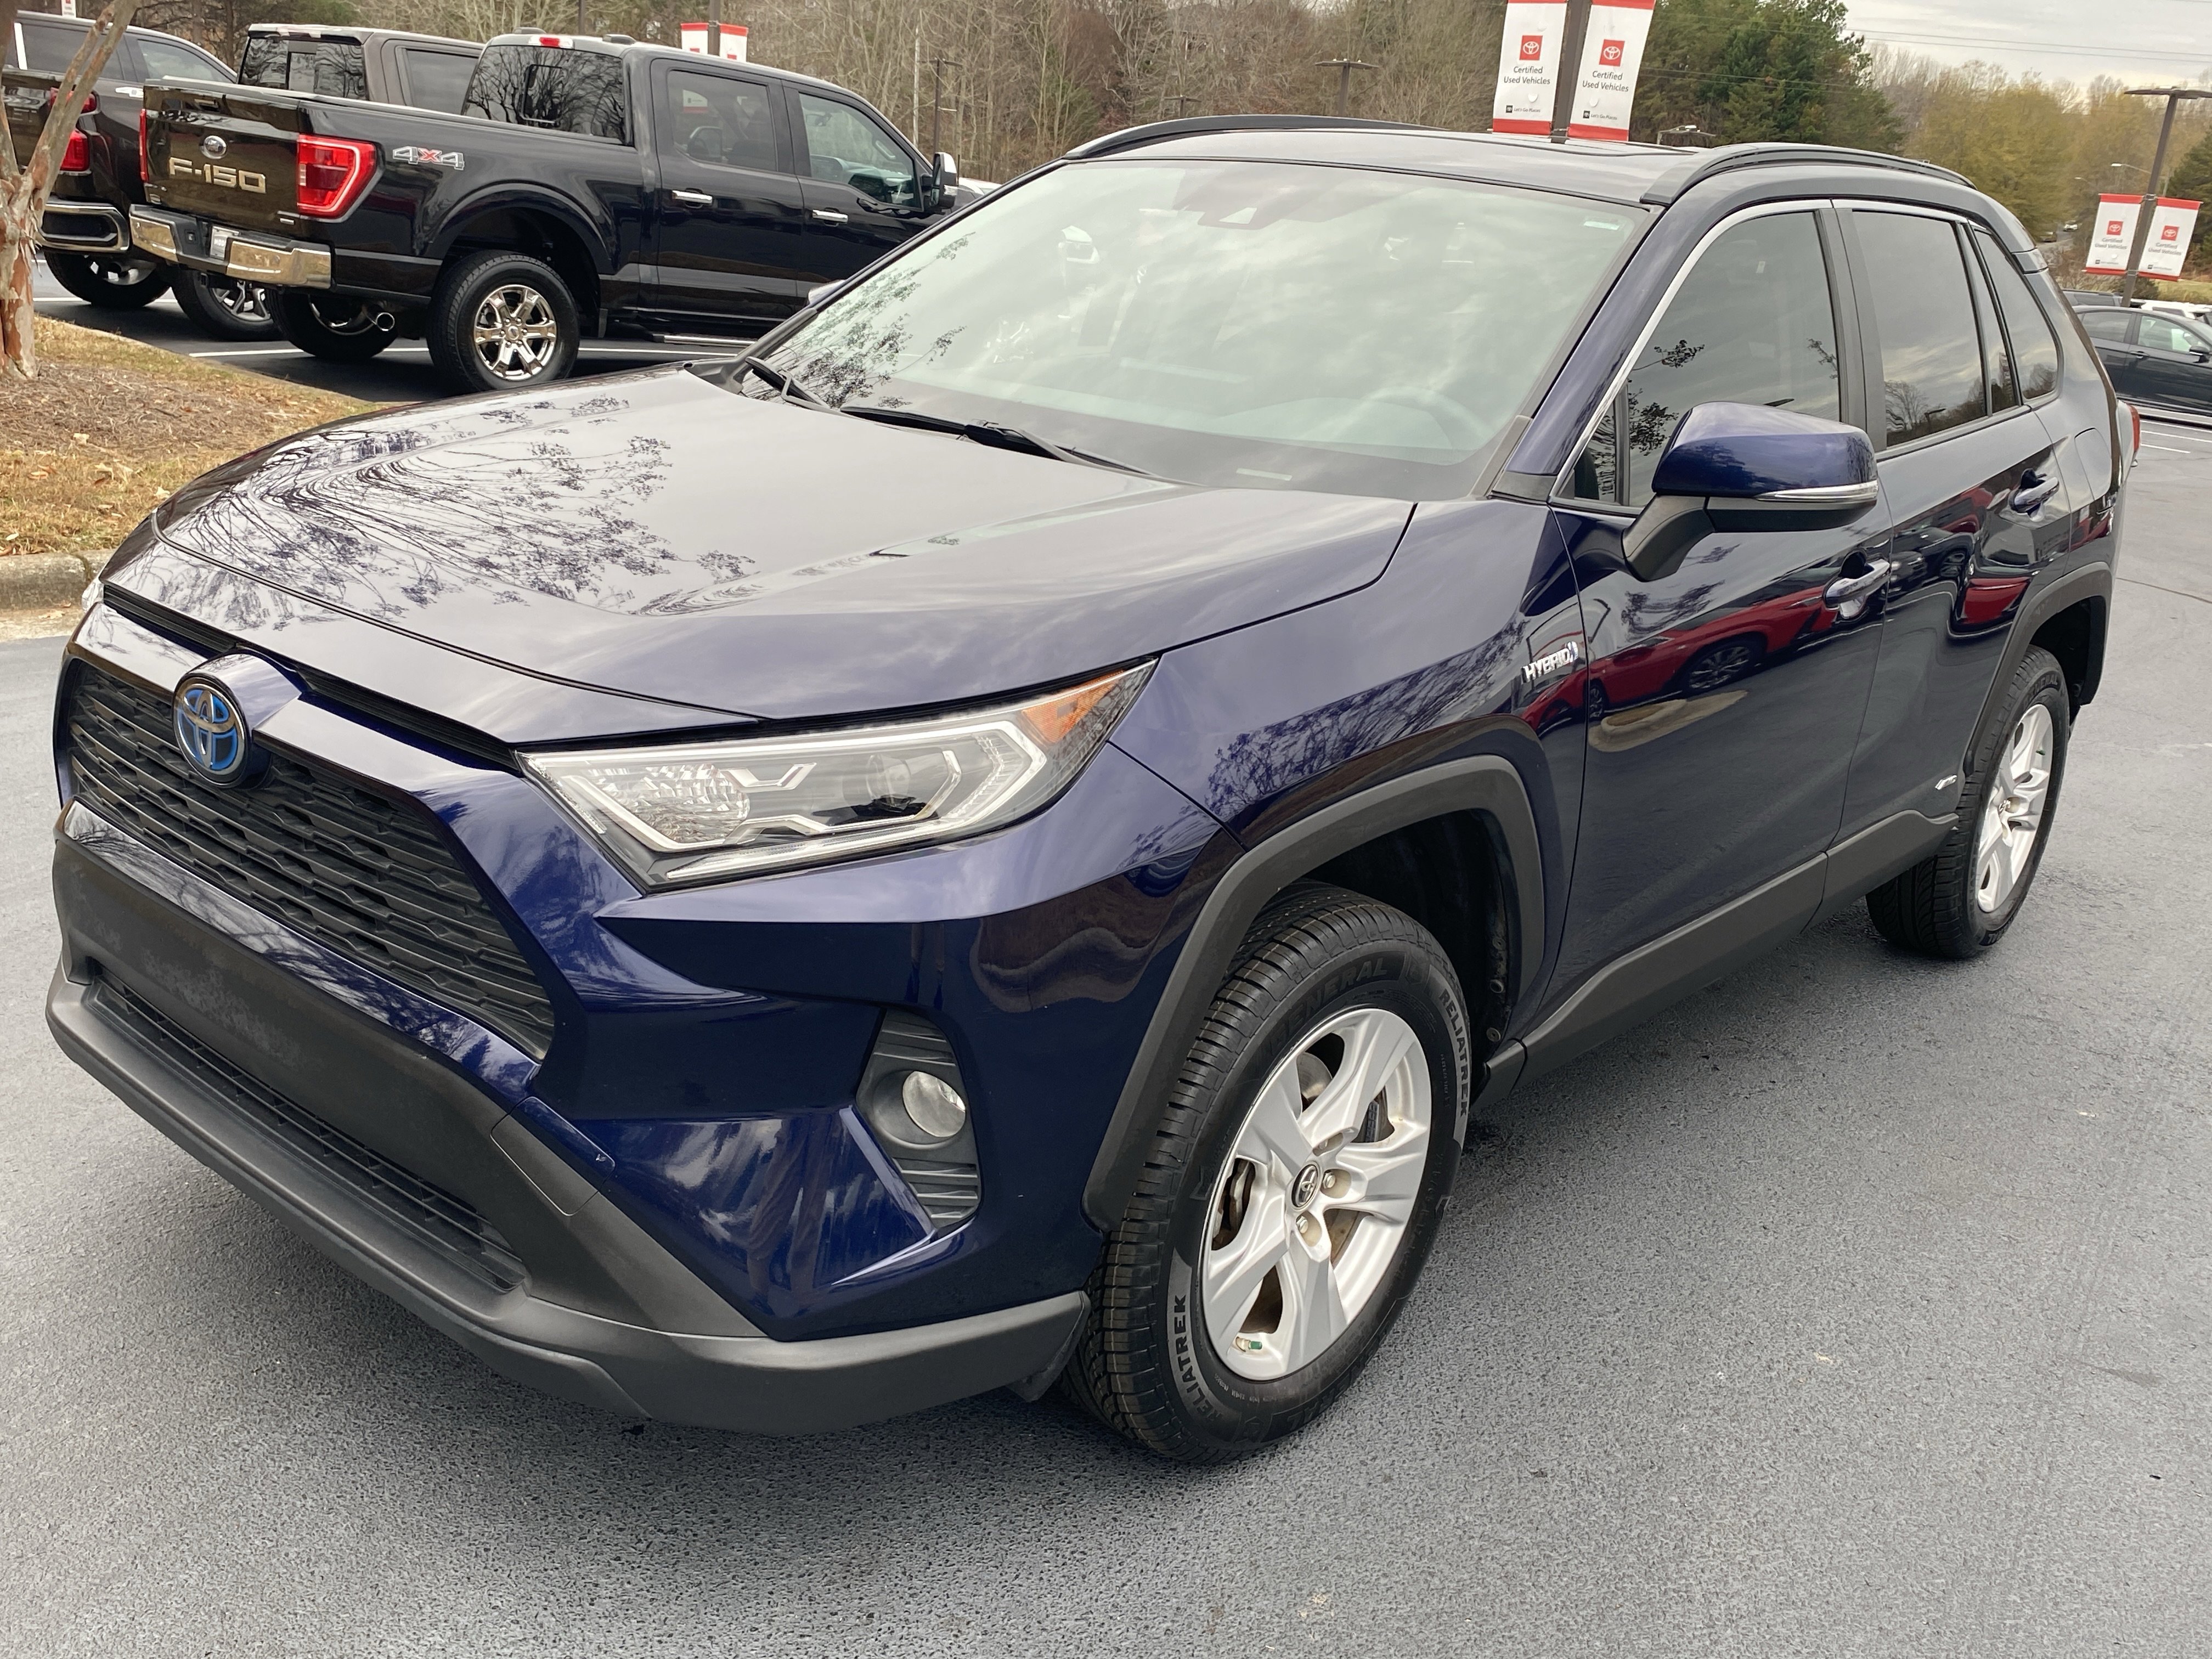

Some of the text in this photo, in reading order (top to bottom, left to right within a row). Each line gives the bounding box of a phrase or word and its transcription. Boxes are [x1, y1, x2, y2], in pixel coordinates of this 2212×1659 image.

[1513, 66, 1543, 74] Certified
[1592, 70, 1623, 80] Certified
[1582, 81, 1629, 92] Used Vehicles
[169, 156, 266, 194] F-150
[1521, 648, 1571, 683] HYBRID
[1438, 988, 1469, 1117] RELIATREK
